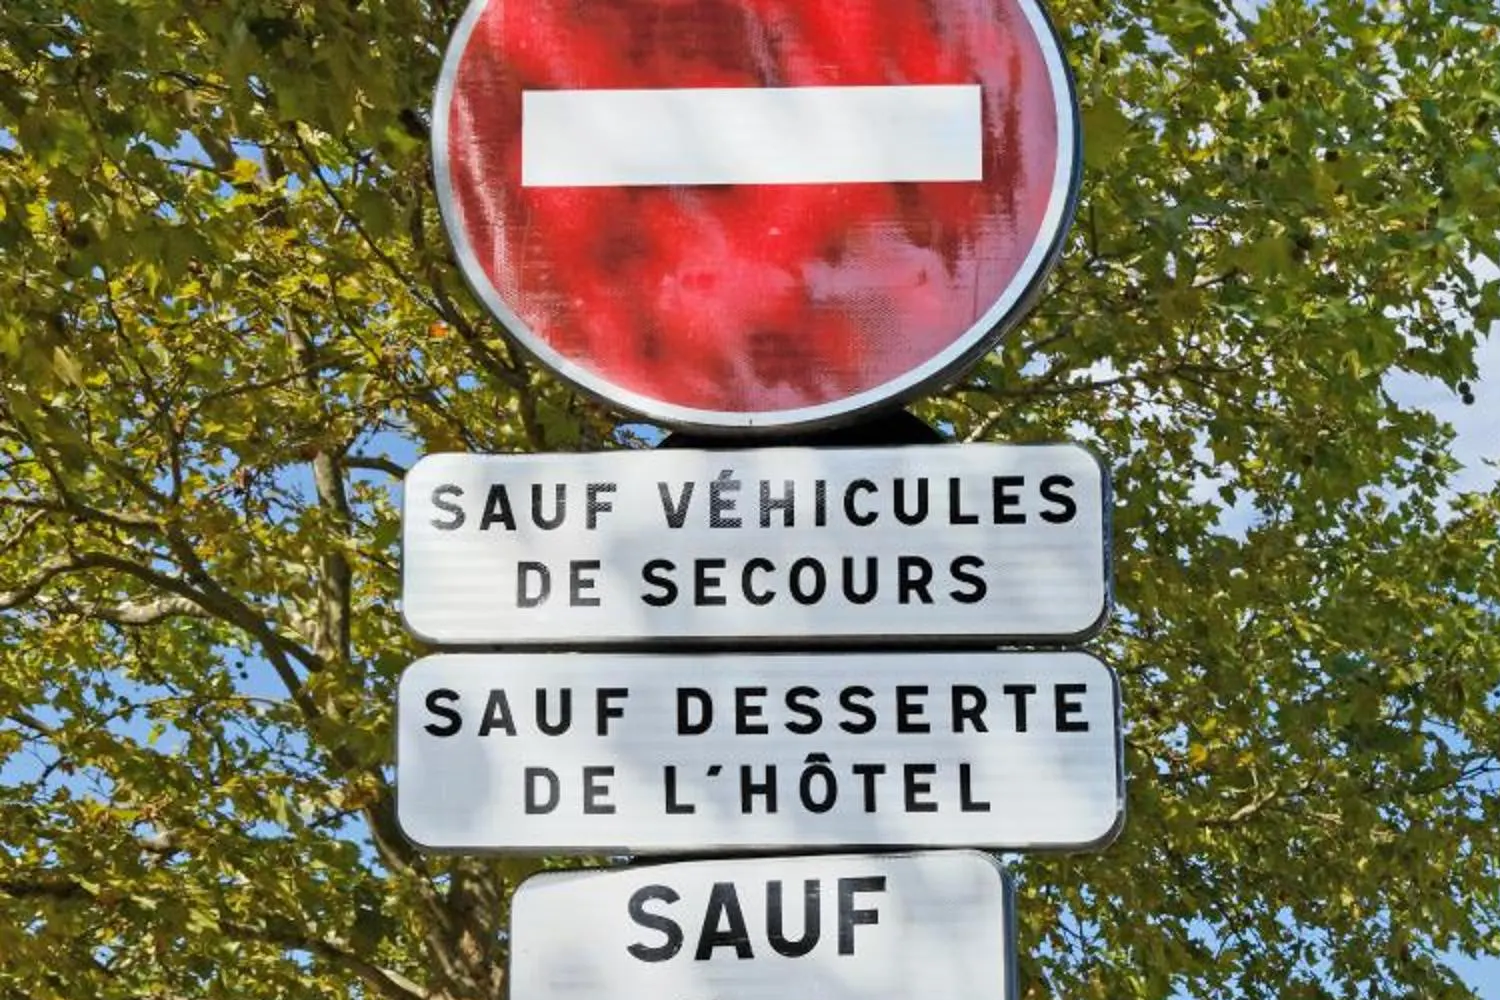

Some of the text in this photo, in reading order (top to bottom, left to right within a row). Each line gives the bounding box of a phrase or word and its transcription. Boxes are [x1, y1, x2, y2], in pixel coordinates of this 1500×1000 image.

[430, 469, 1077, 532] SAUF VÉHICULES
[516, 555, 989, 608] DE SECOURS
[425, 683, 1090, 738] SAUF DESSERTE
[524, 752, 991, 815] DE L'HÔTEL
[626, 876, 887, 962] SAUF
